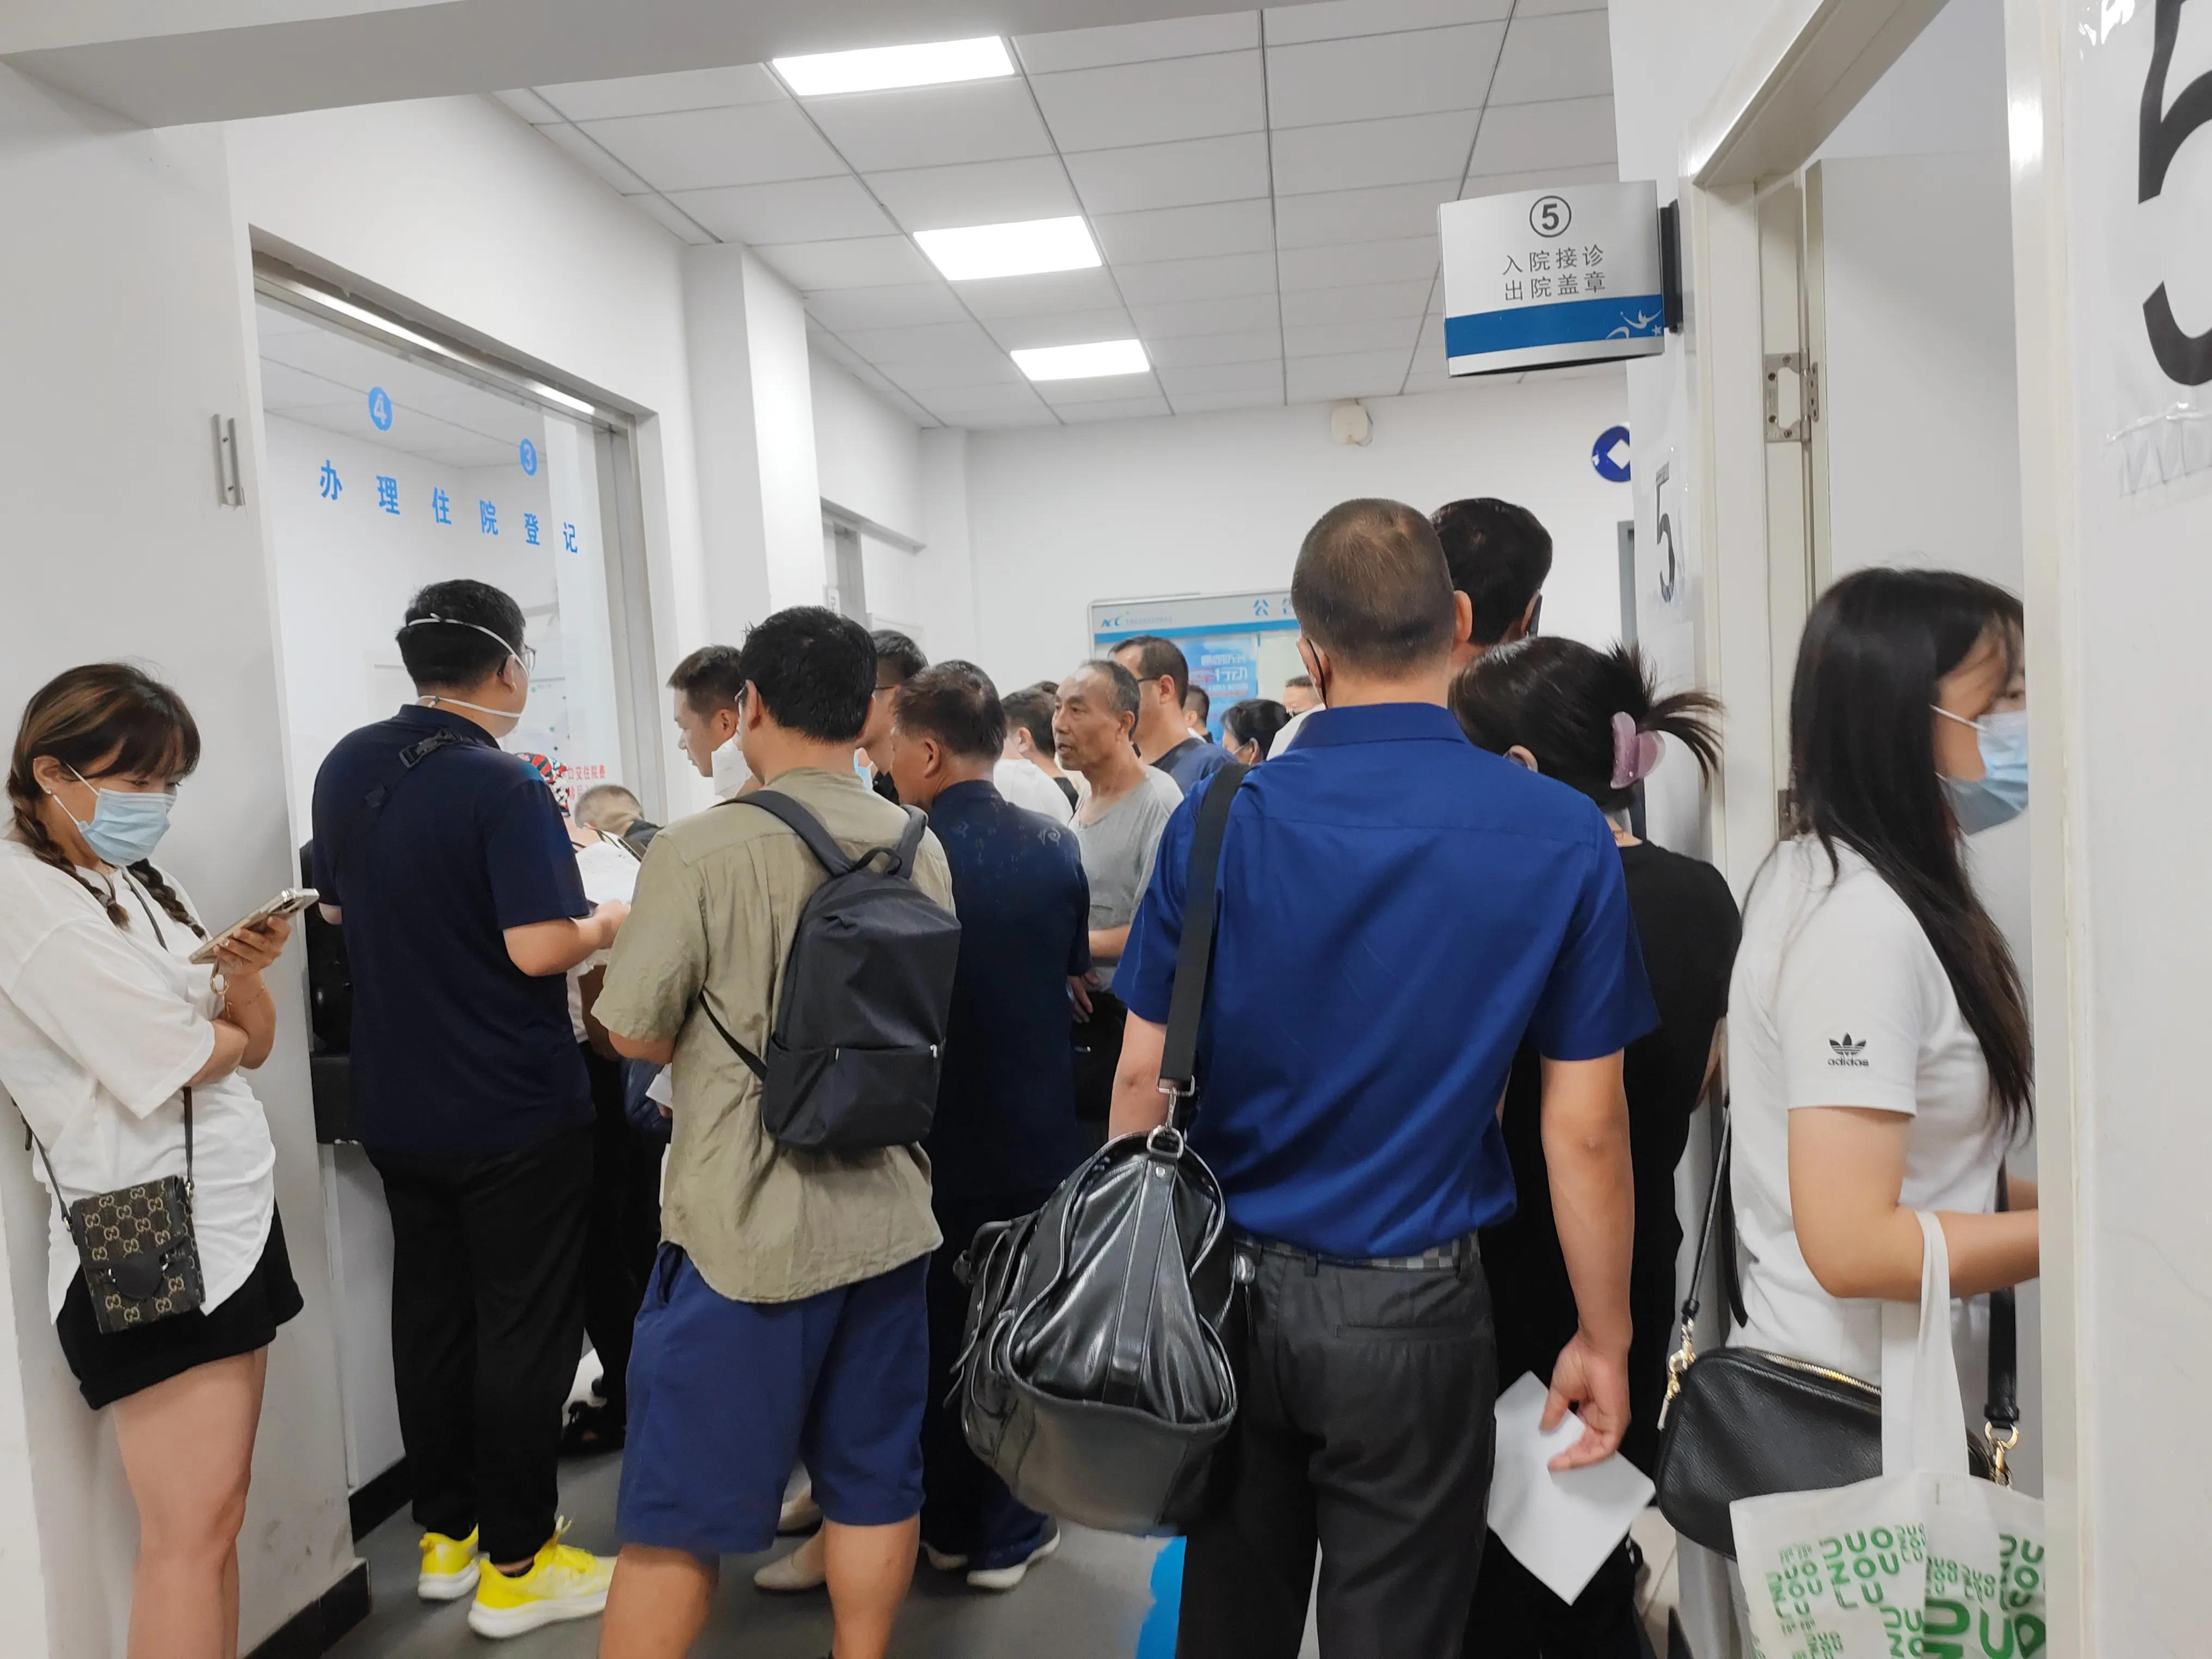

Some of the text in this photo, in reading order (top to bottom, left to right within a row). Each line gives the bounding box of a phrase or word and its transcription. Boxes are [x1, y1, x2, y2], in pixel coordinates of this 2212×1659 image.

[1503, 244, 1603, 275] 入院接诊
[1504, 271, 1606, 301] 出院盖章
[319, 459, 578, 553] 办理住院登记
[1656, 461, 1675, 603] 5
[1827, 1056, 1869, 1066] adidas
